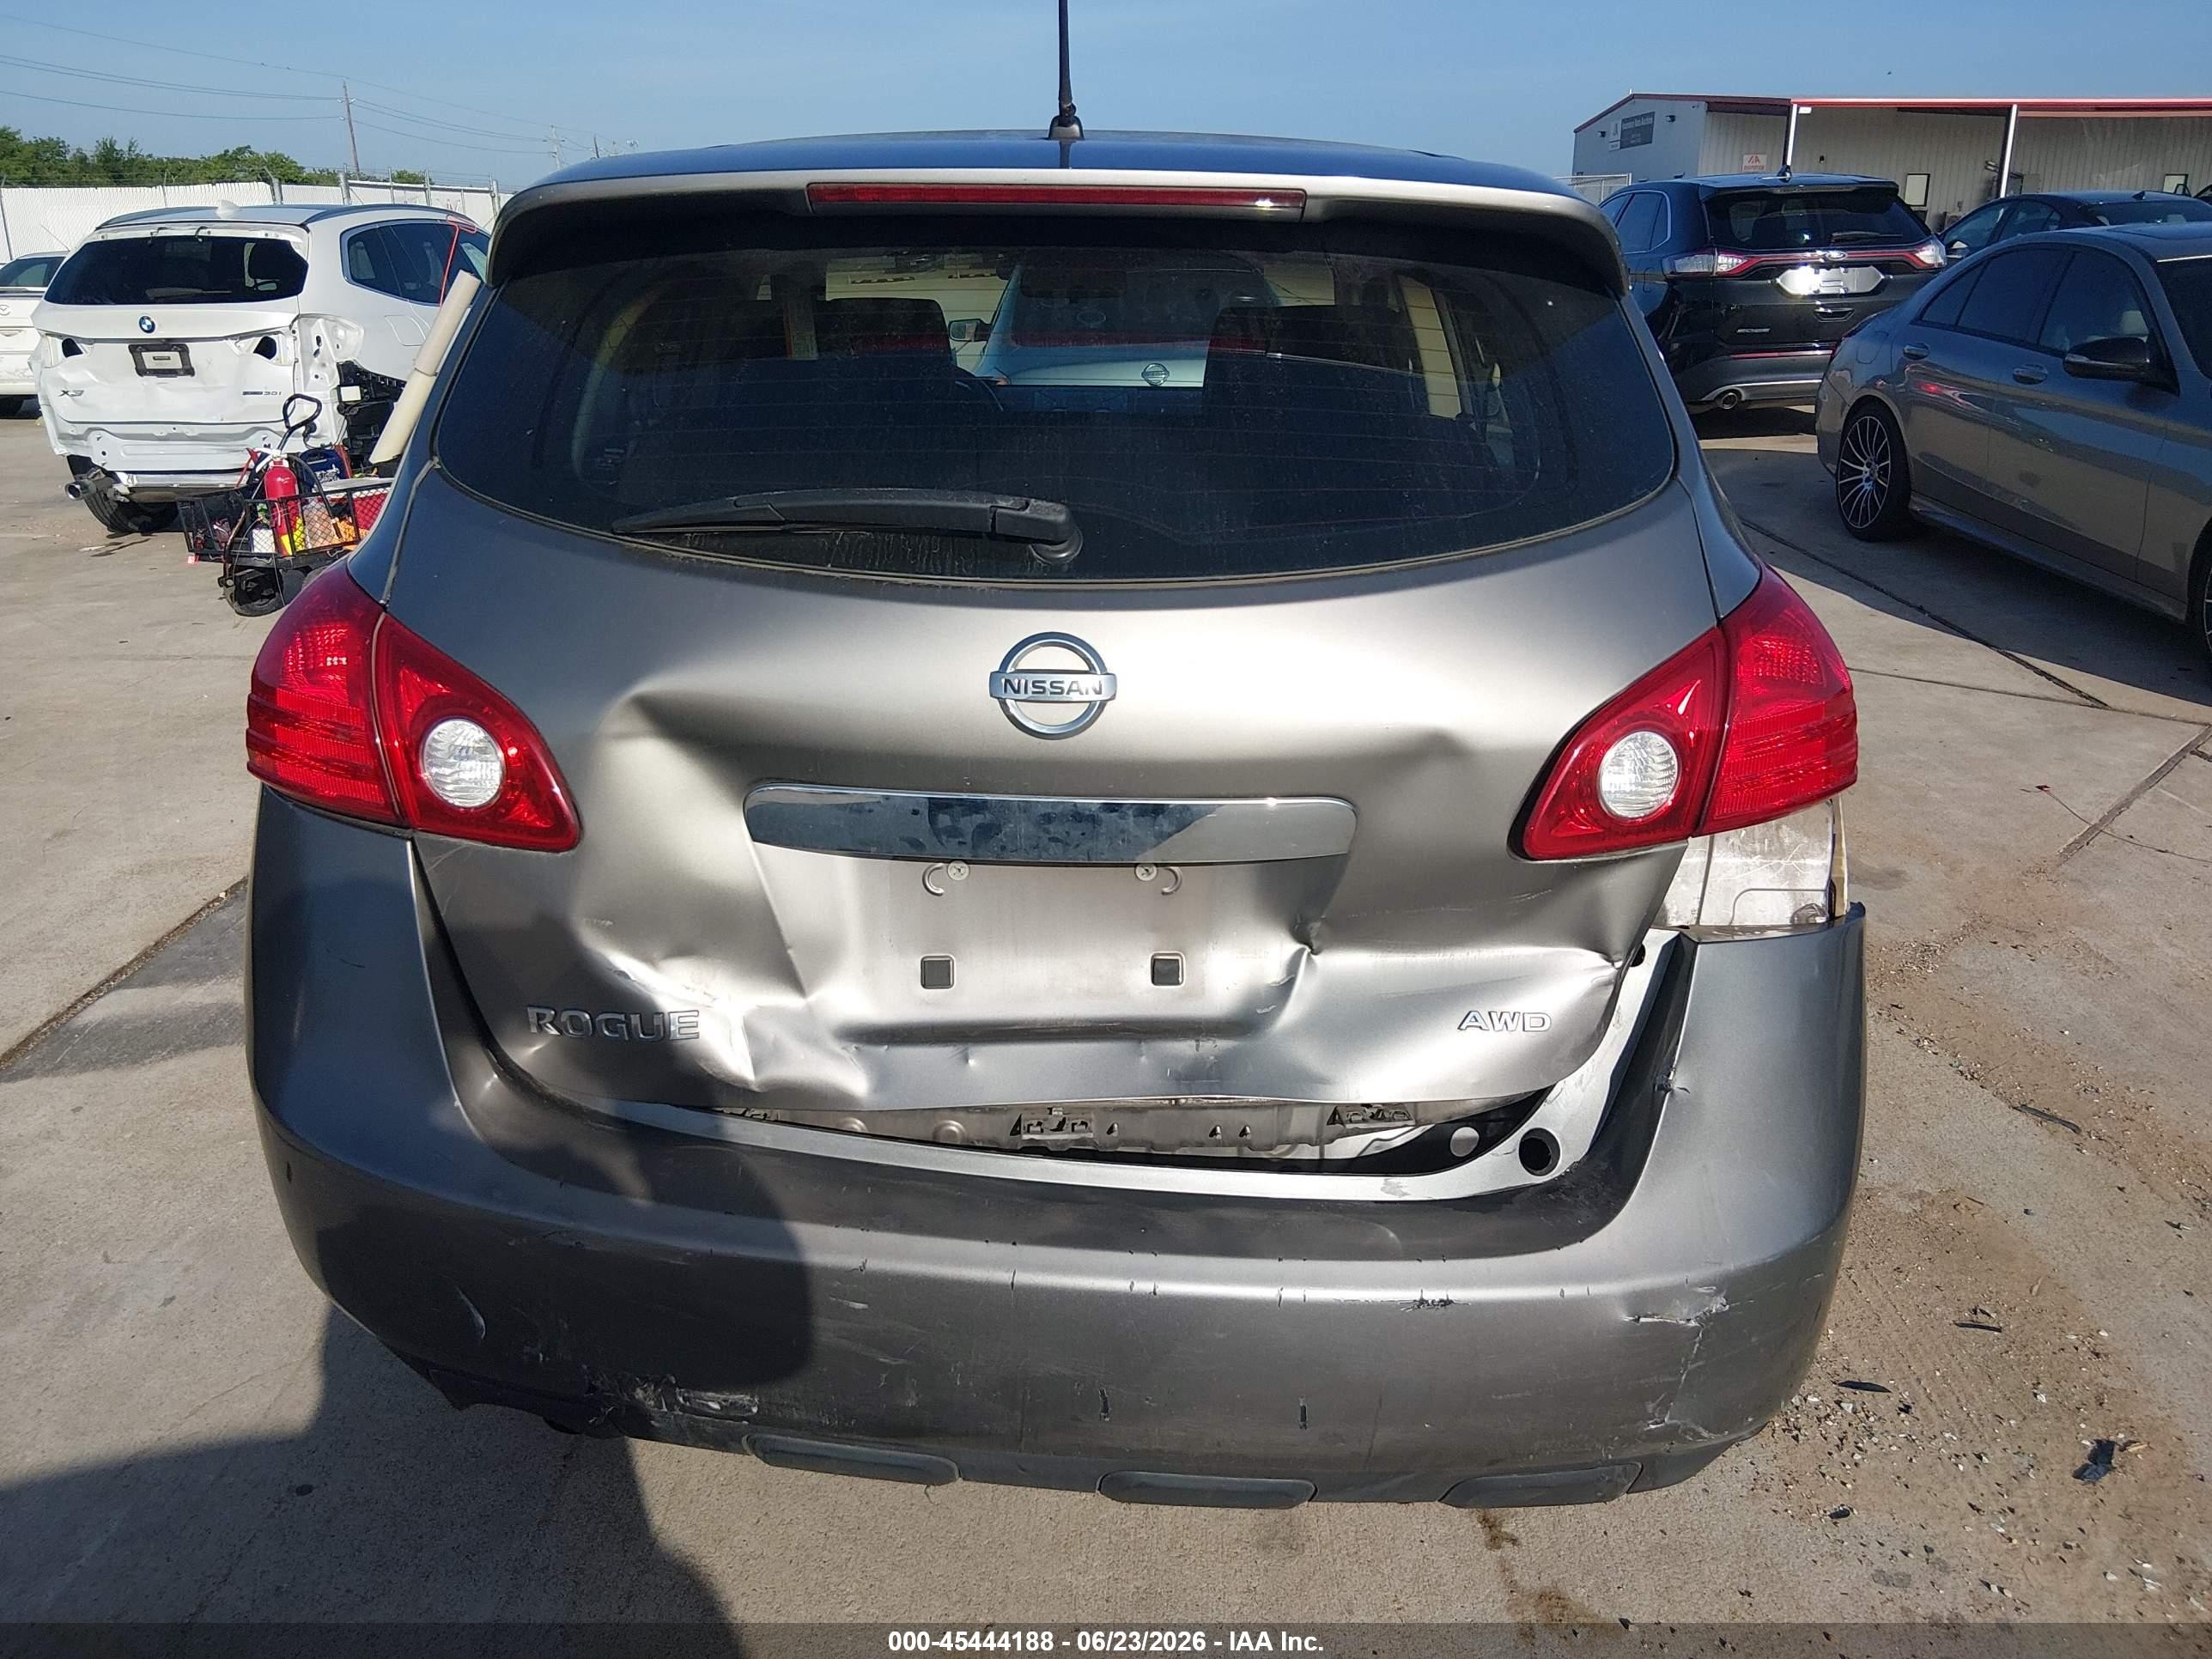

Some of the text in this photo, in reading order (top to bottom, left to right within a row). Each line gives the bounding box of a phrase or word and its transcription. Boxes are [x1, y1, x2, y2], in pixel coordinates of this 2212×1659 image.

[1003, 678, 1103, 696] NISSAN
[526, 1005, 701, 1042] ROGUE
[1457, 1010, 1553, 1032] AWD
